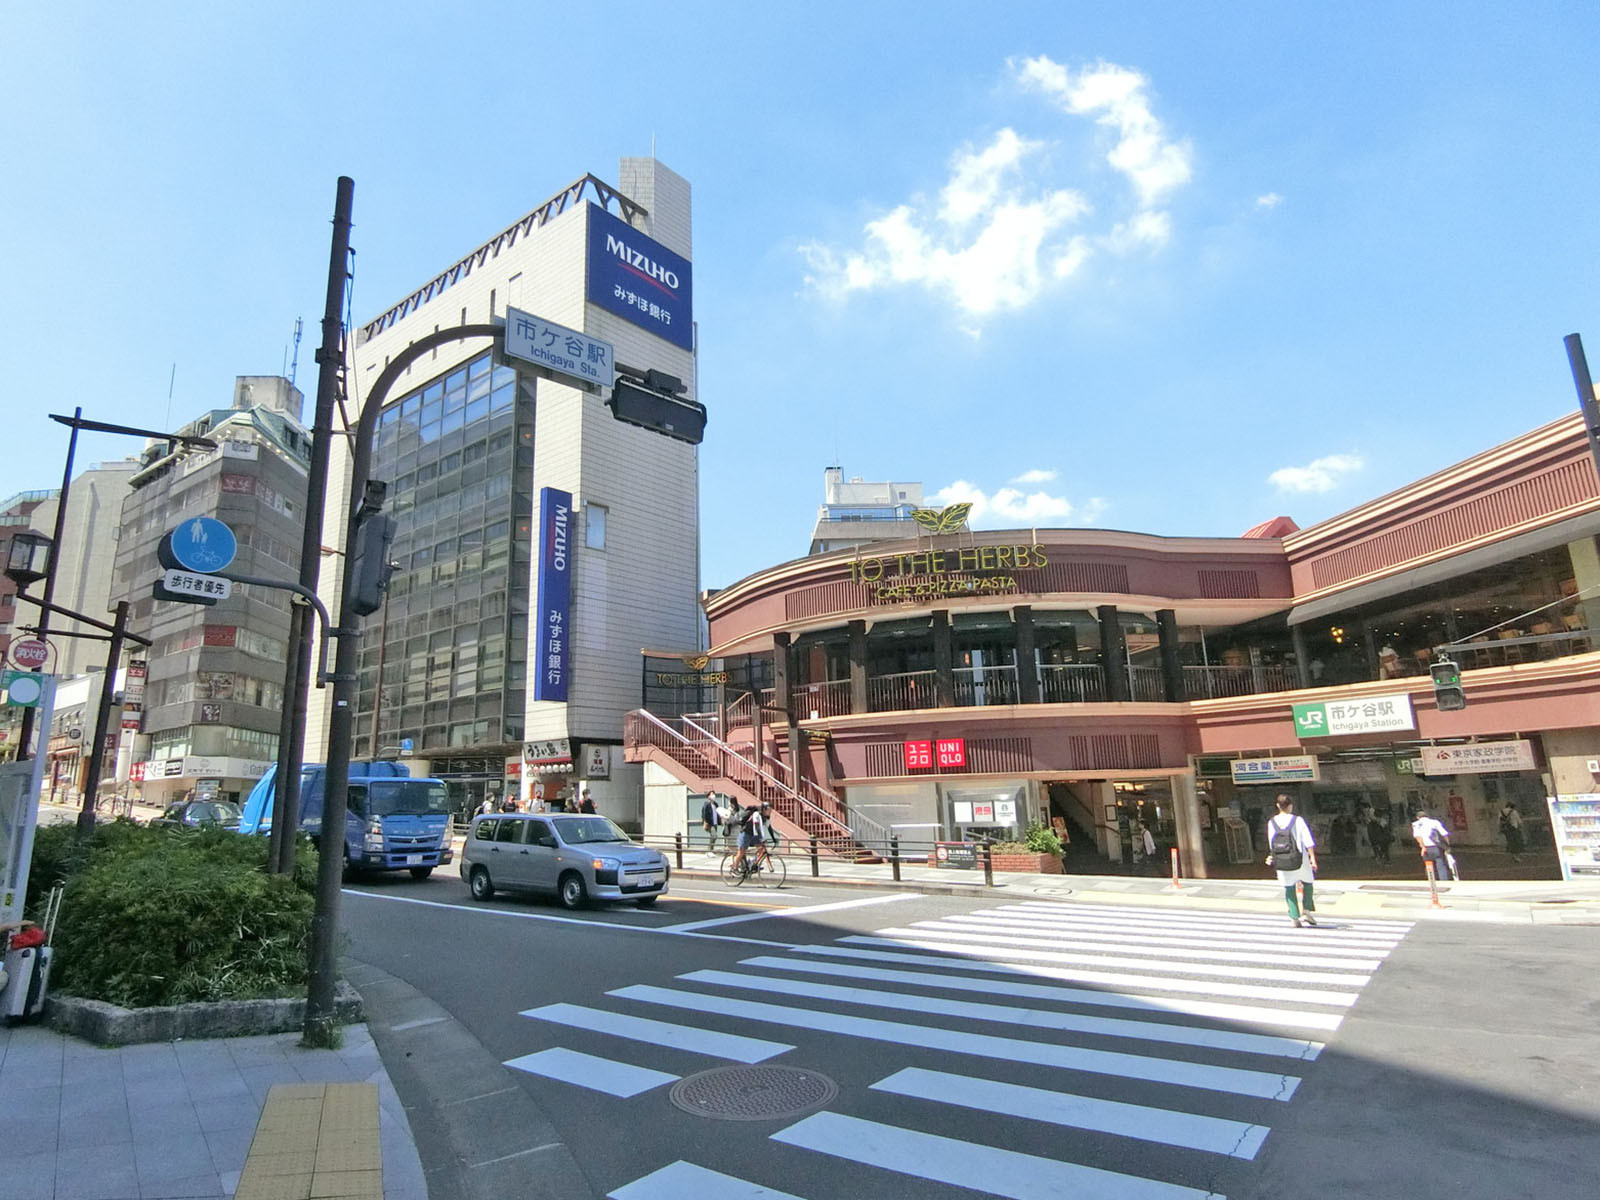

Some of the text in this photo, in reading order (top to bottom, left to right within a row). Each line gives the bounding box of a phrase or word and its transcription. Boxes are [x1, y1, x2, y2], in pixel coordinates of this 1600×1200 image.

[606, 233, 679, 289] MIZUHO
[614, 284, 671, 325] みずほ銀行
[530, 345, 601, 378] Ichigaya Sta.
[554, 504, 568, 571] MIZUHO
[848, 544, 1048, 585] TO THE HERBS
[171, 575, 225, 595] 歩行者優先
[916, 586, 926, 596] &
[930, 579, 969, 594] PIZZA
[973, 576, 1017, 590] PASTA
[15, 647, 46, 661] 消火栓
[548, 609, 563, 685] みずほ銀行
[1298, 711, 1323, 725] JR
[1333, 718, 1404, 733] Ichigaya Station
[1453, 746, 1516, 759] 東京家政学院
